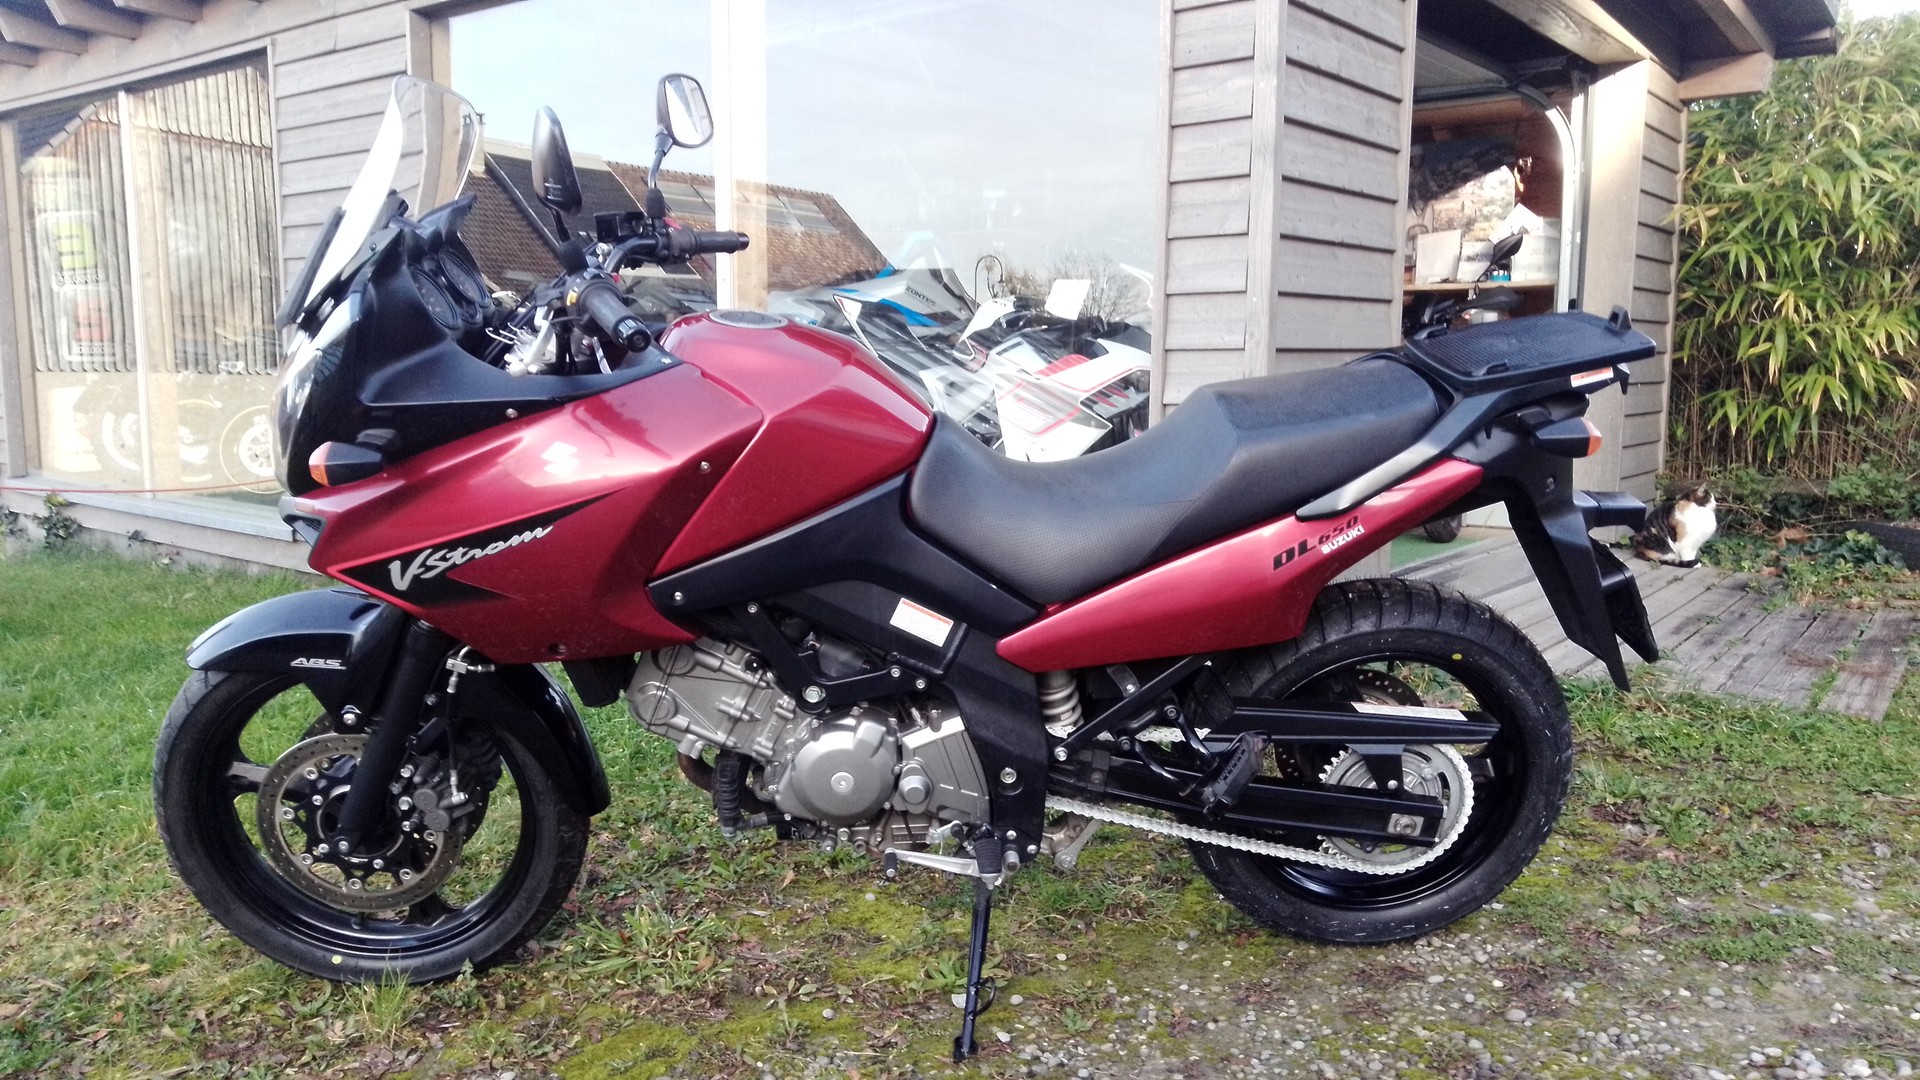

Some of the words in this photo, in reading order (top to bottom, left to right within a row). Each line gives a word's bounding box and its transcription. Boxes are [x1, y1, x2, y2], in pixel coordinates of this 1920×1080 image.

[905, 285, 937, 308] ZONTES
[1320, 524, 1365, 555] SUZUKI
[388, 525, 553, 591] V-Strom
[290, 657, 343, 668] ABS
